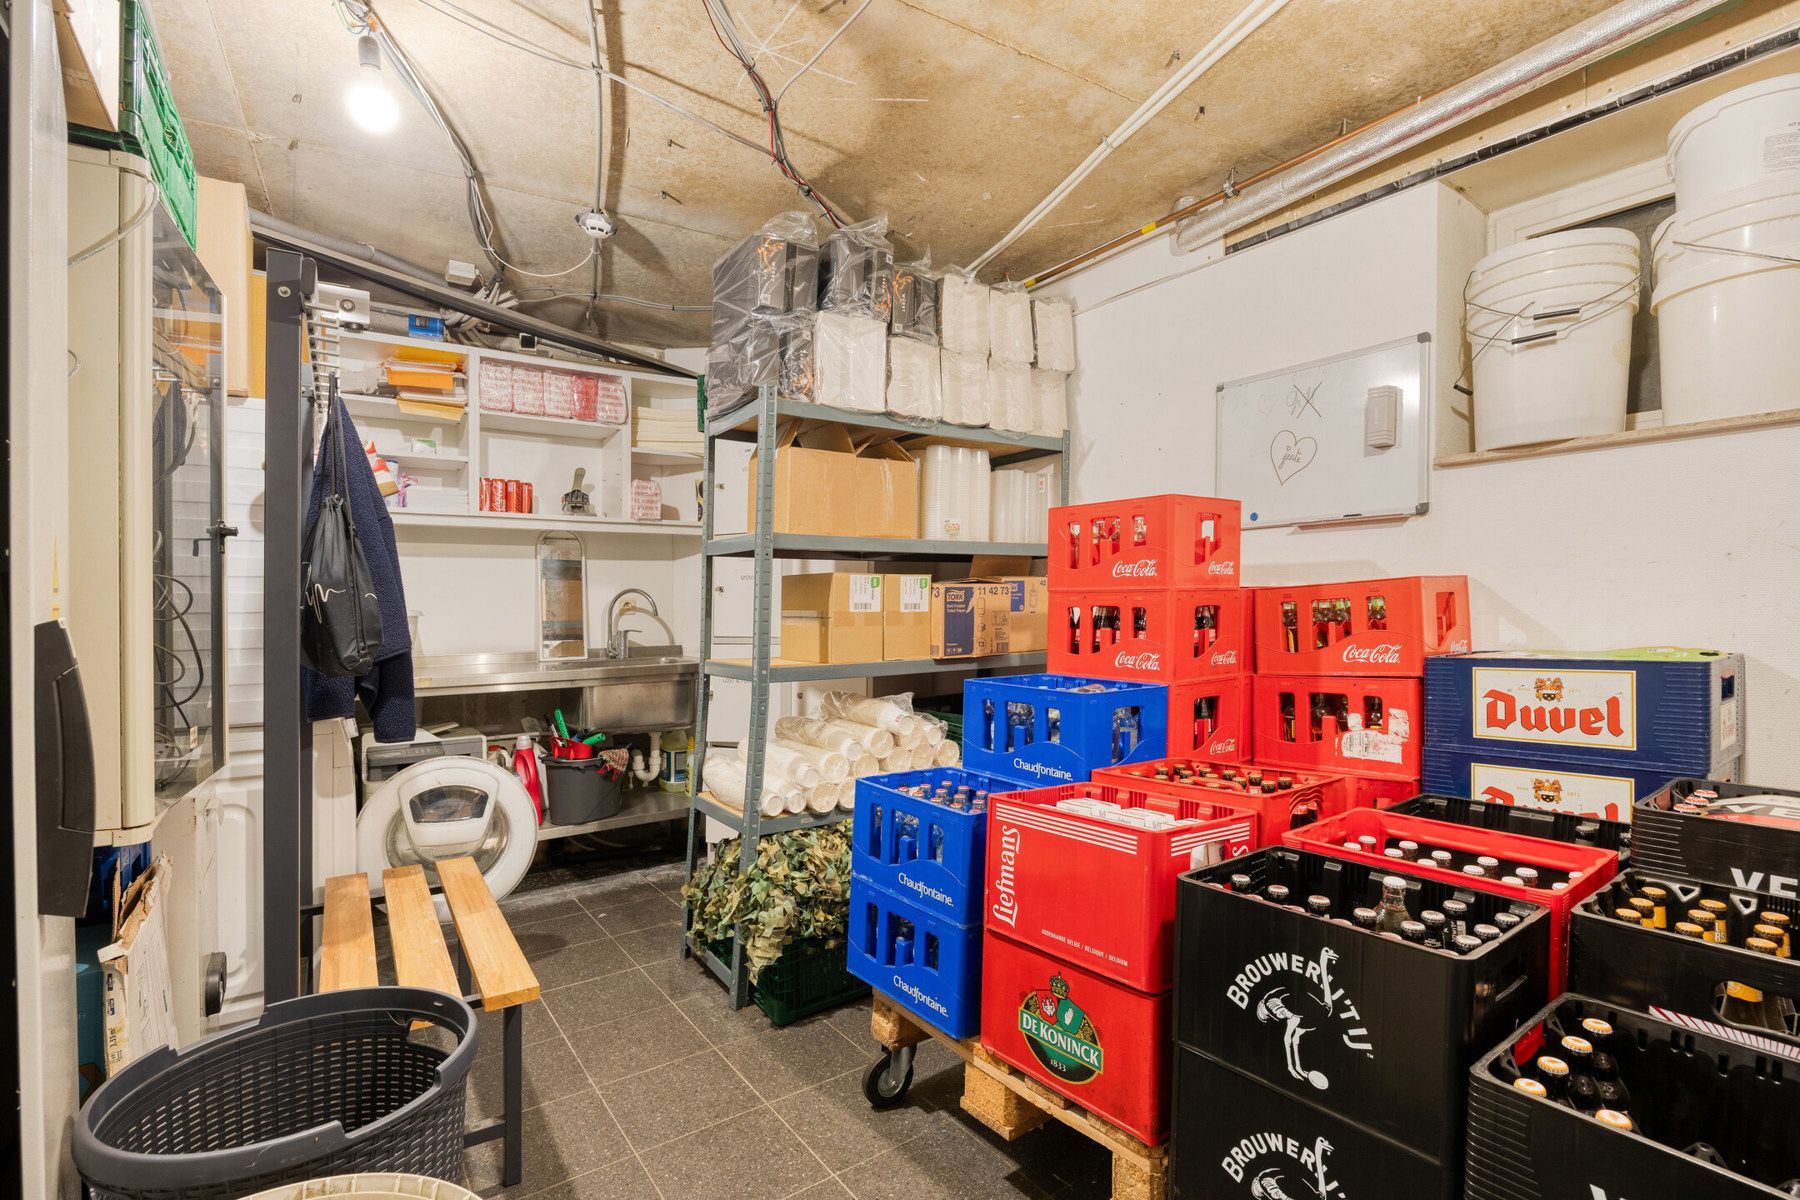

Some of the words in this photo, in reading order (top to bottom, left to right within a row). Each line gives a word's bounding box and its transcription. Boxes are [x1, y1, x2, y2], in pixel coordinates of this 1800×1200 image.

[1112, 558, 1157, 578] Coca-Cola
[1208, 561, 1234, 576] Coca-Cola
[946, 592, 965, 601] TORK
[989, 587, 998, 595] 42
[1000, 587, 1010, 595] 73
[1115, 650, 1160, 671] Coca-Cola
[1211, 650, 1237, 666] Coca-Cola
[1342, 644, 1402, 664] Coca-Cola
[1482, 688, 1624, 738] Duvel
[1209, 738, 1236, 755] Coca-Cola
[1013, 757, 1073, 781] Chaudfontaine
[993, 825, 1020, 930] Liefmans
[898, 872, 954, 907] Chaudfontaine
[1084, 945, 1104, 958] BELGIQUE
[1108, 954, 1128, 966] BELGIUM
[893, 974, 949, 1018] Chaudfontaine
[1022, 1012, 1038, 1035] DE
[1040, 1022, 1100, 1068] KONINCK
[1050, 1058, 1067, 1072] 1833
